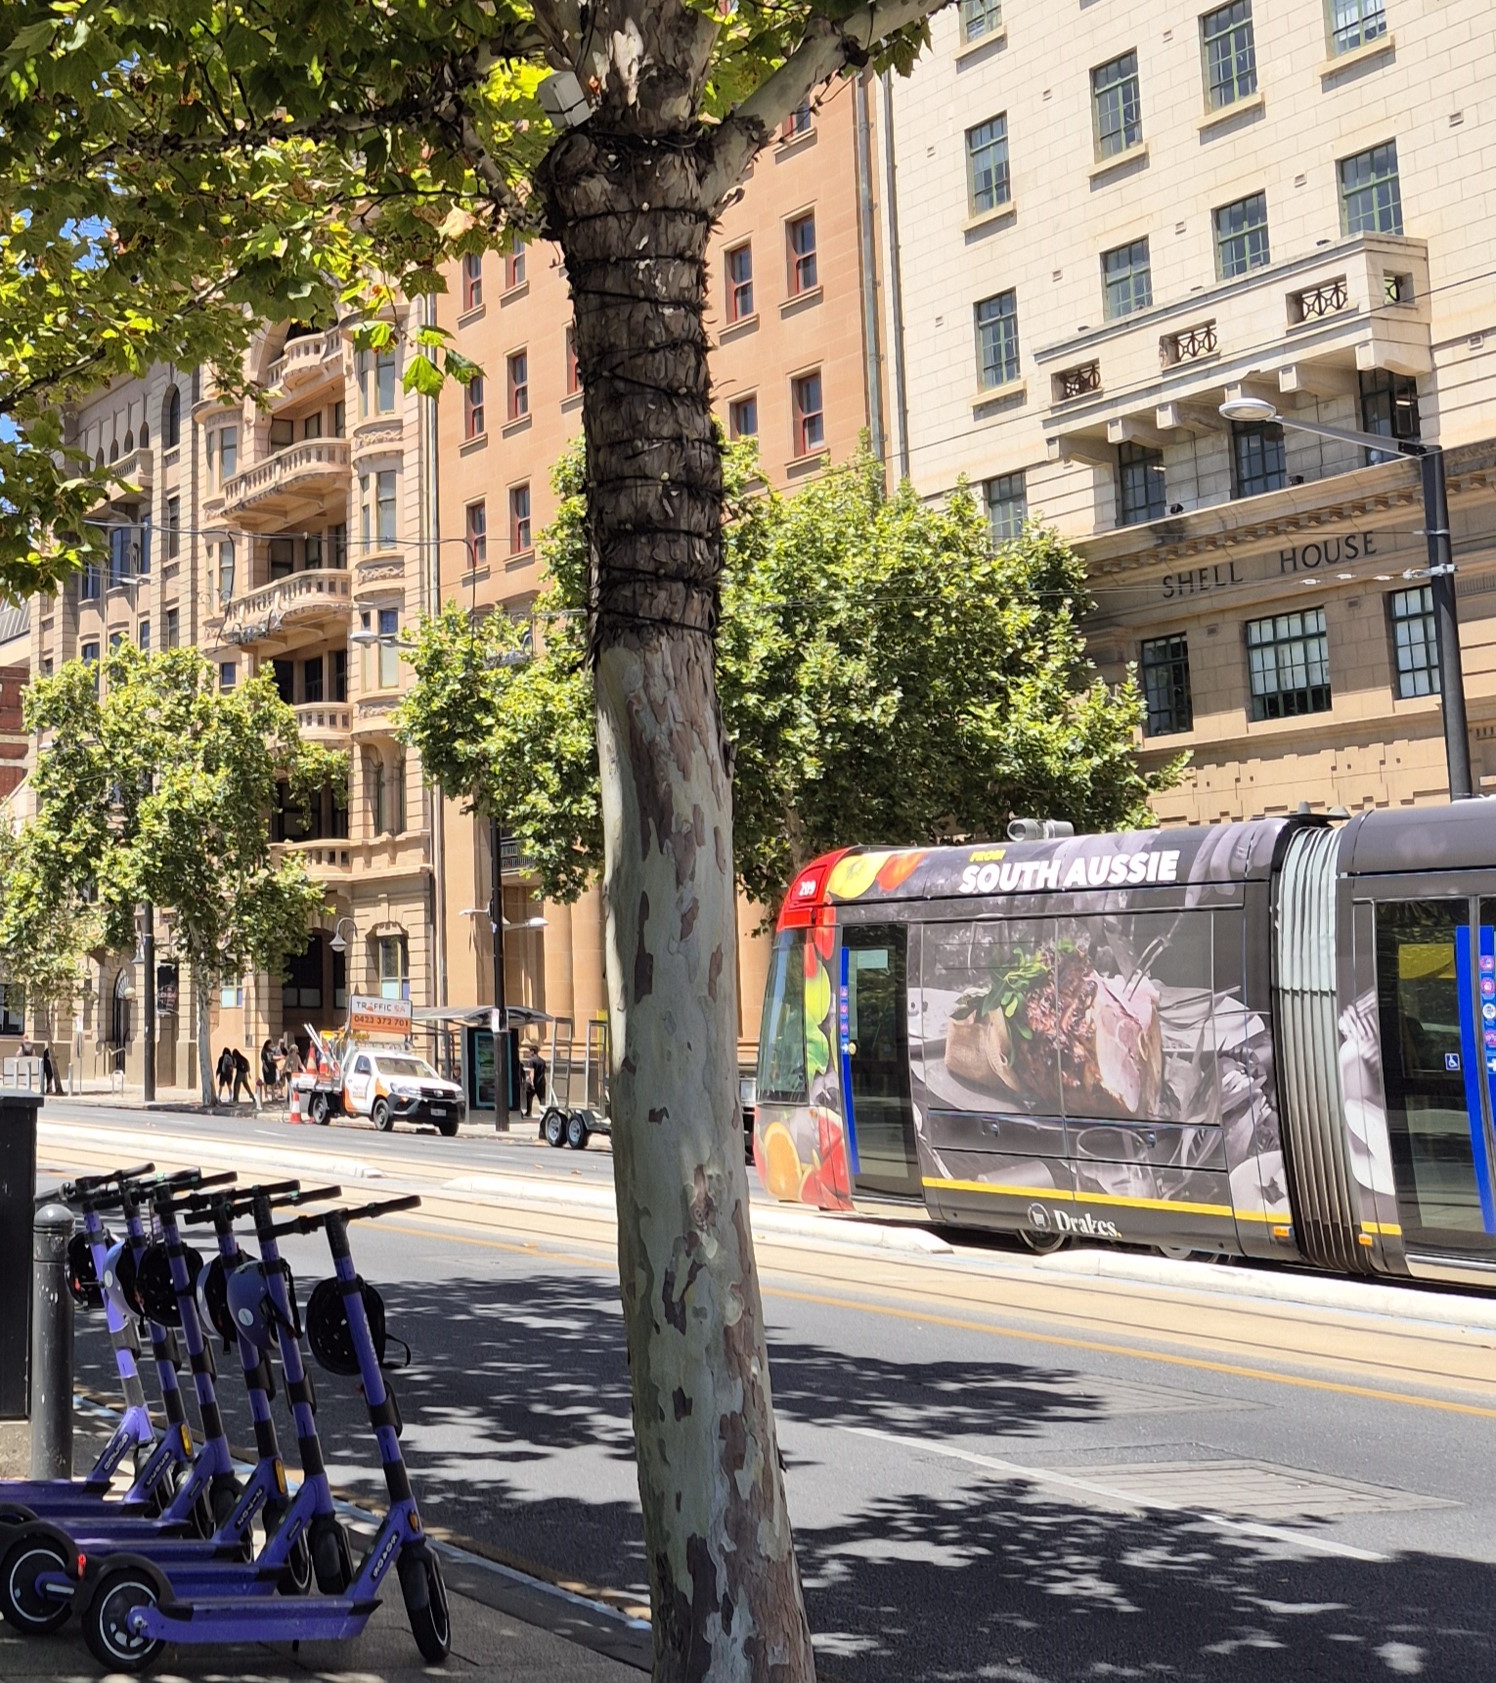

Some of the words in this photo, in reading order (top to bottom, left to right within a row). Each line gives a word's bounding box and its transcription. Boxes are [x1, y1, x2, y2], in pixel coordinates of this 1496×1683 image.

[1161, 561, 1244, 599] SHELL
[1280, 530, 1378, 574] HOUSE
[969, 849, 1006, 863] FROM
[958, 858, 1063, 894] SOUTH
[1063, 850, 1180, 887] AUSSIE
[799, 879, 816, 897] 209
